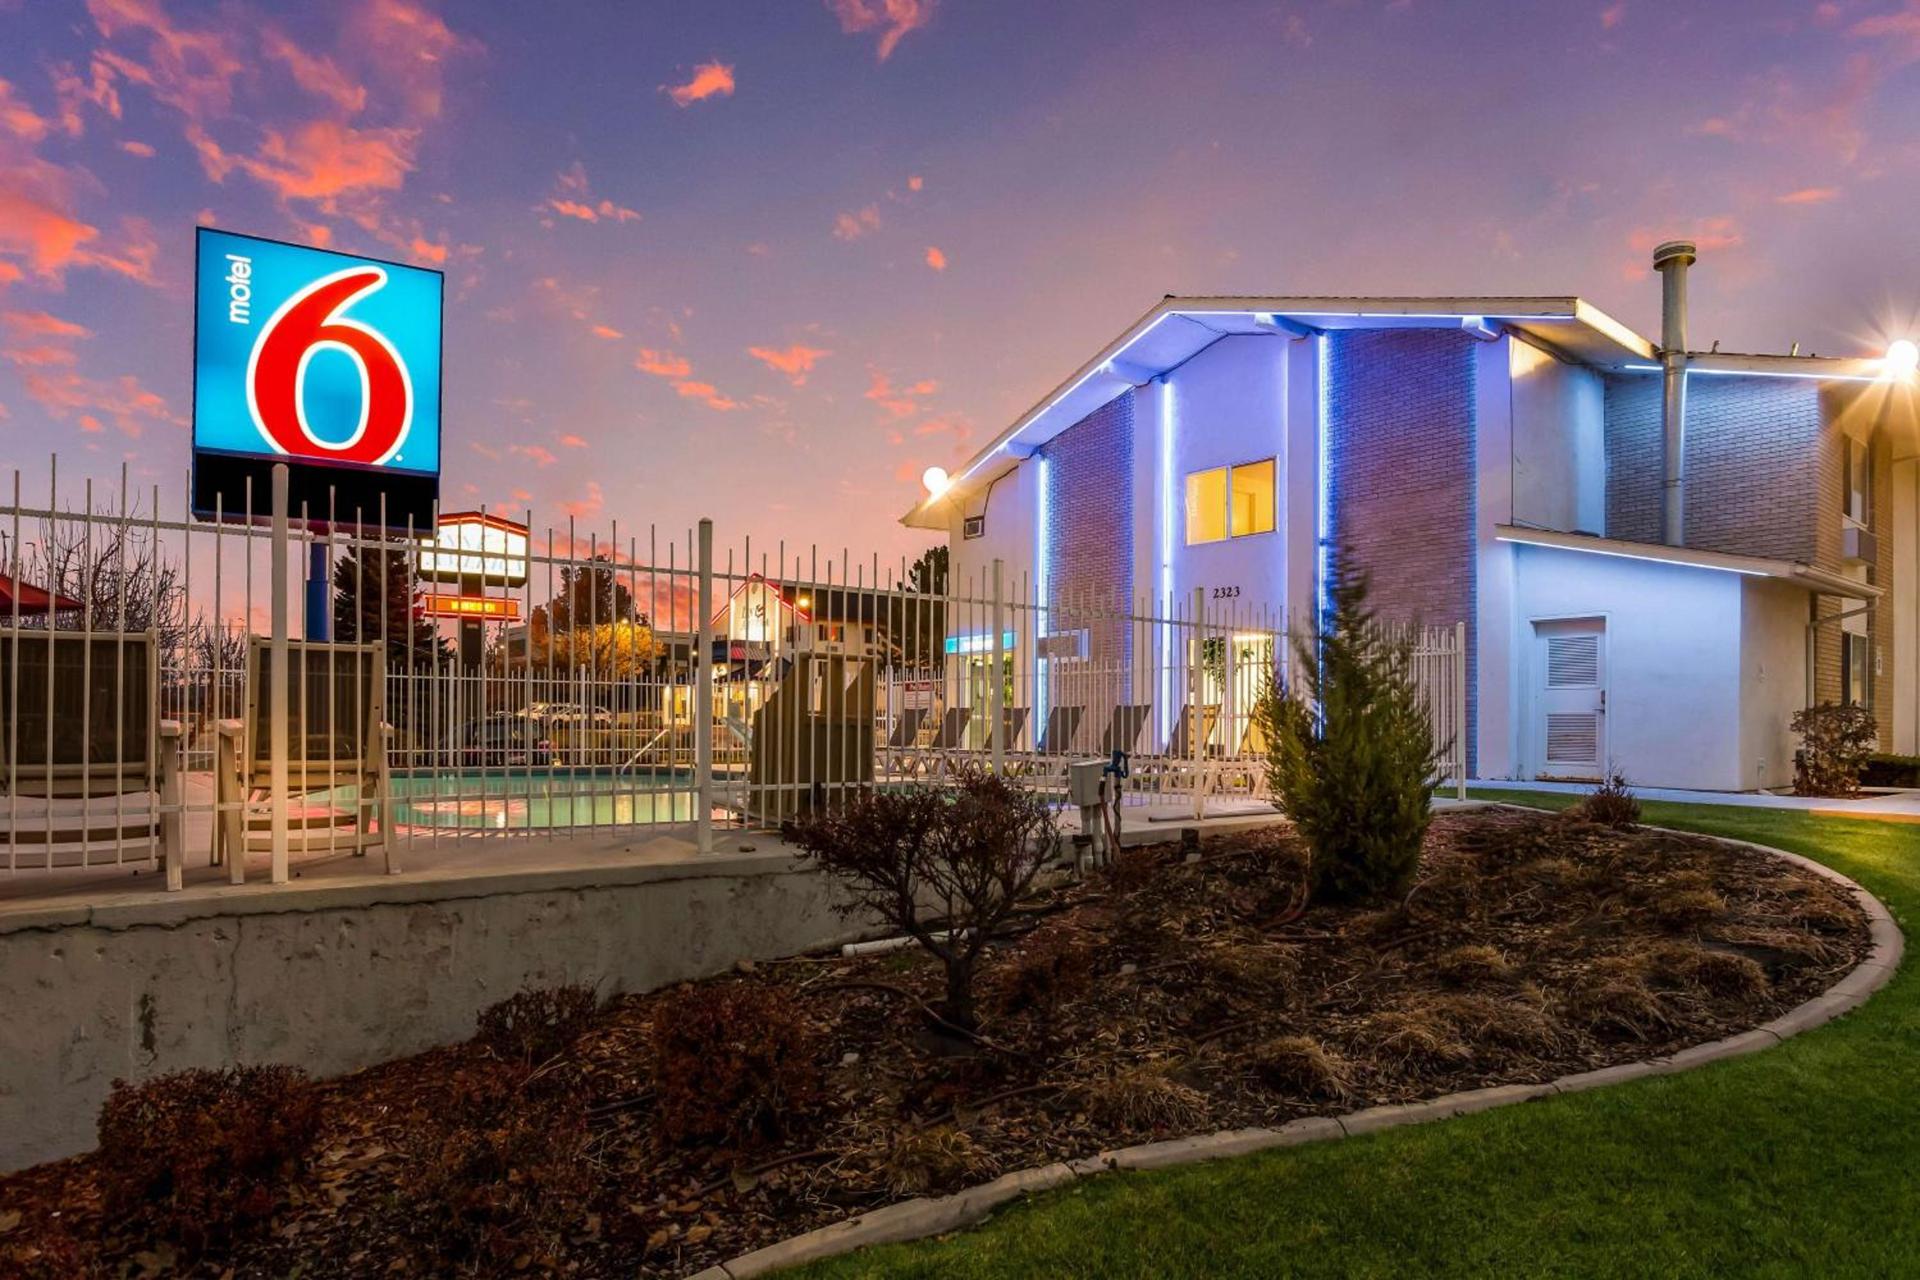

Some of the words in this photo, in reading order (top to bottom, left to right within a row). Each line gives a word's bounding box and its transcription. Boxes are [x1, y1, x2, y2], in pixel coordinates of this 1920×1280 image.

[225, 254, 252, 325] motel
[246, 265, 414, 466] 6
[1213, 586, 1240, 599] 2323
